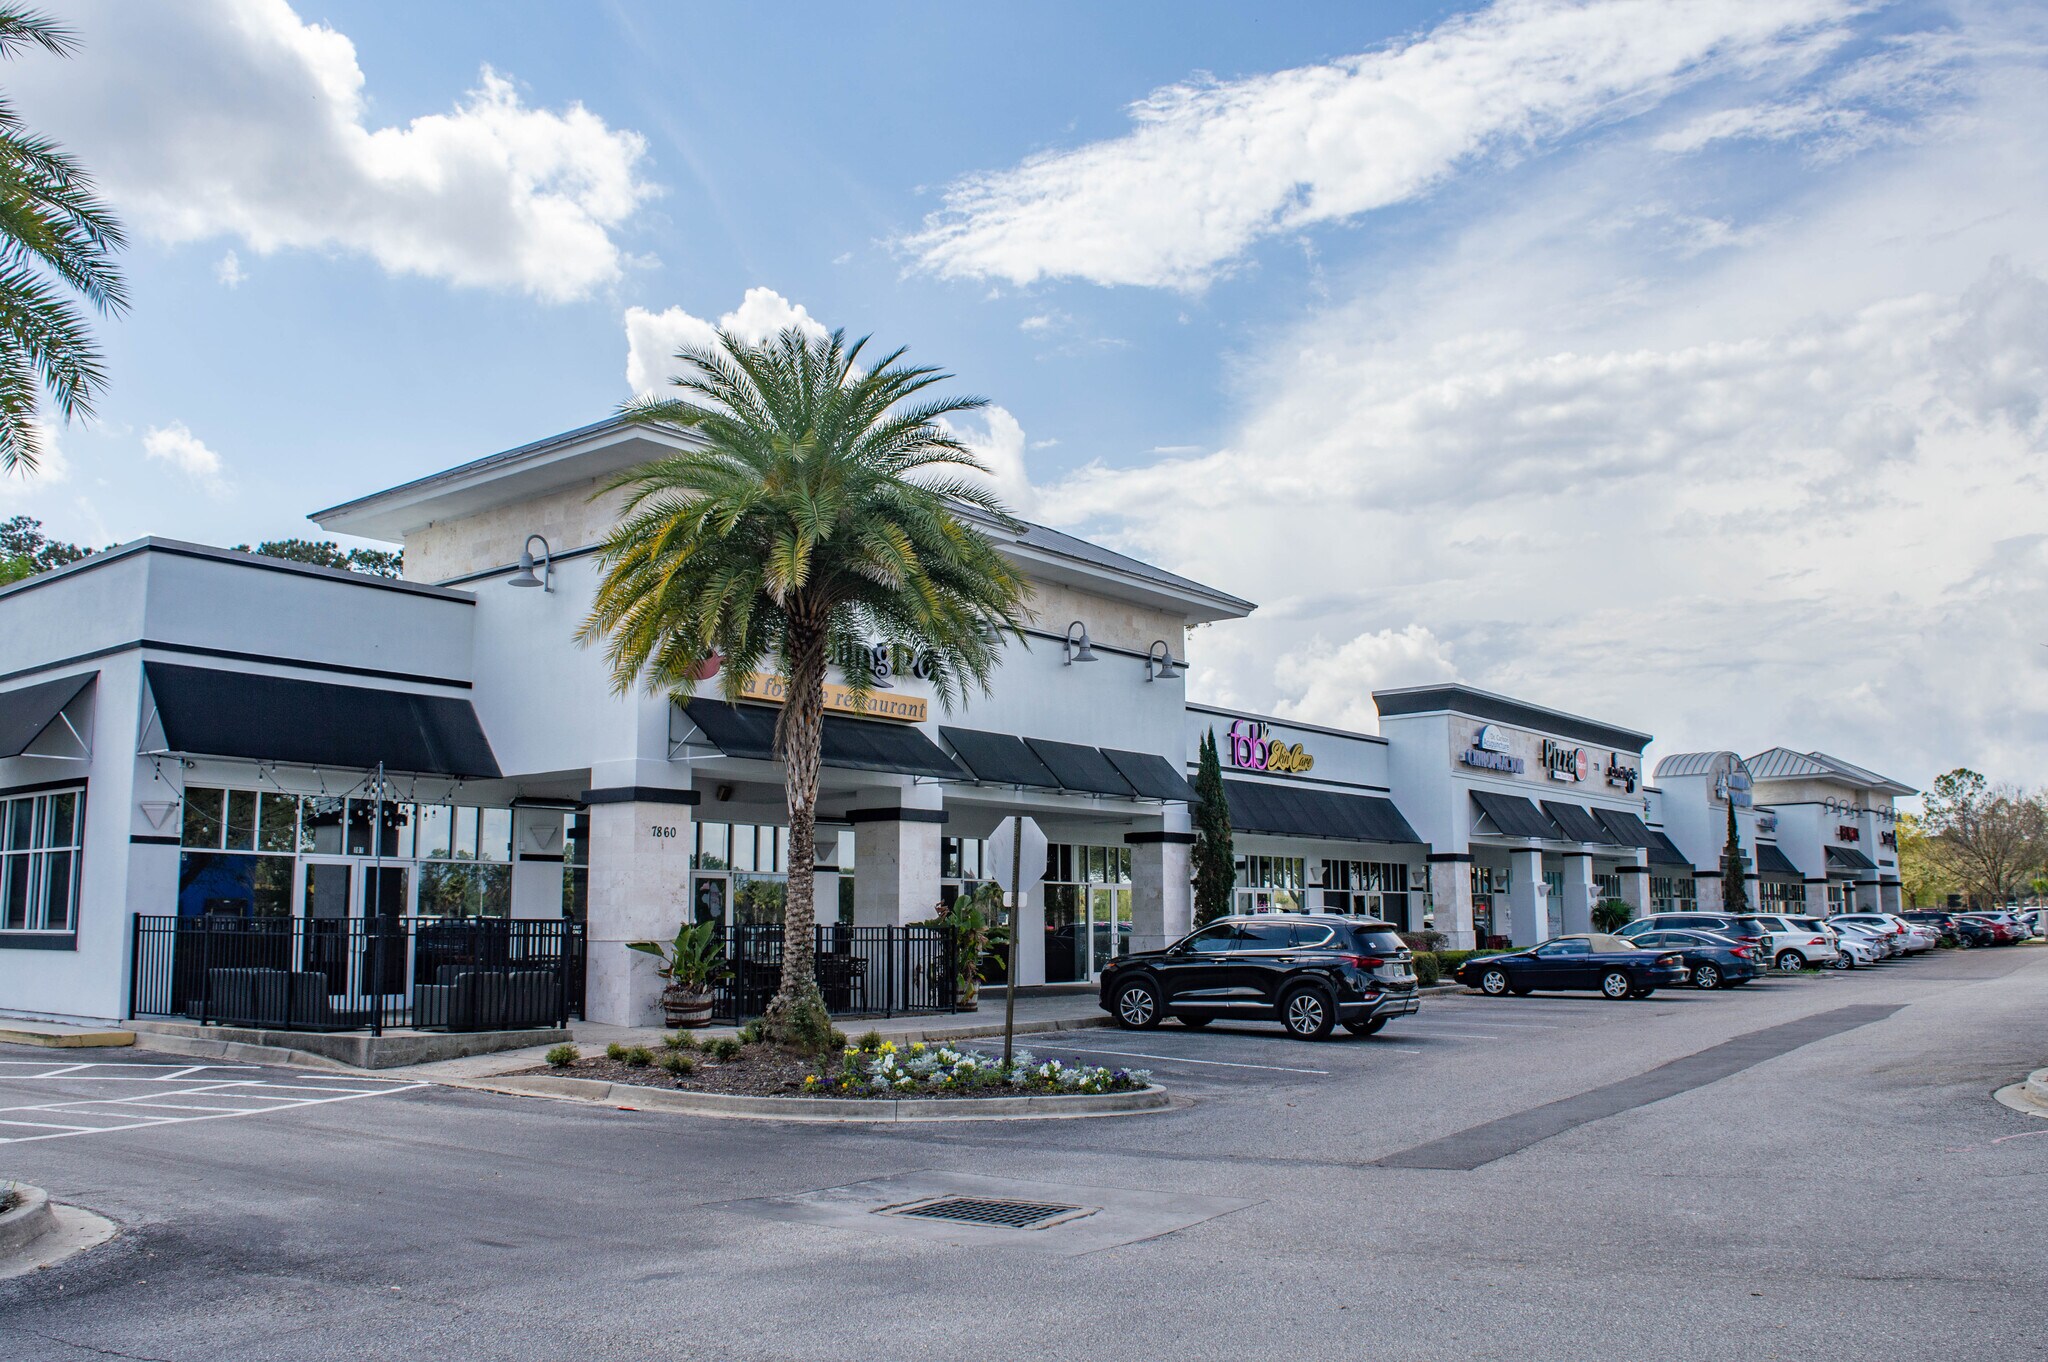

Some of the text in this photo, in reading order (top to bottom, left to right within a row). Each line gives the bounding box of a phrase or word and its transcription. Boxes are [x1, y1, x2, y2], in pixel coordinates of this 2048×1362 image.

[835, 692, 926, 718] reaurant
[1227, 719, 1314, 773] fab Skin Care
[1543, 738, 1575, 773] Pizza
[651, 825, 677, 838] 7860
